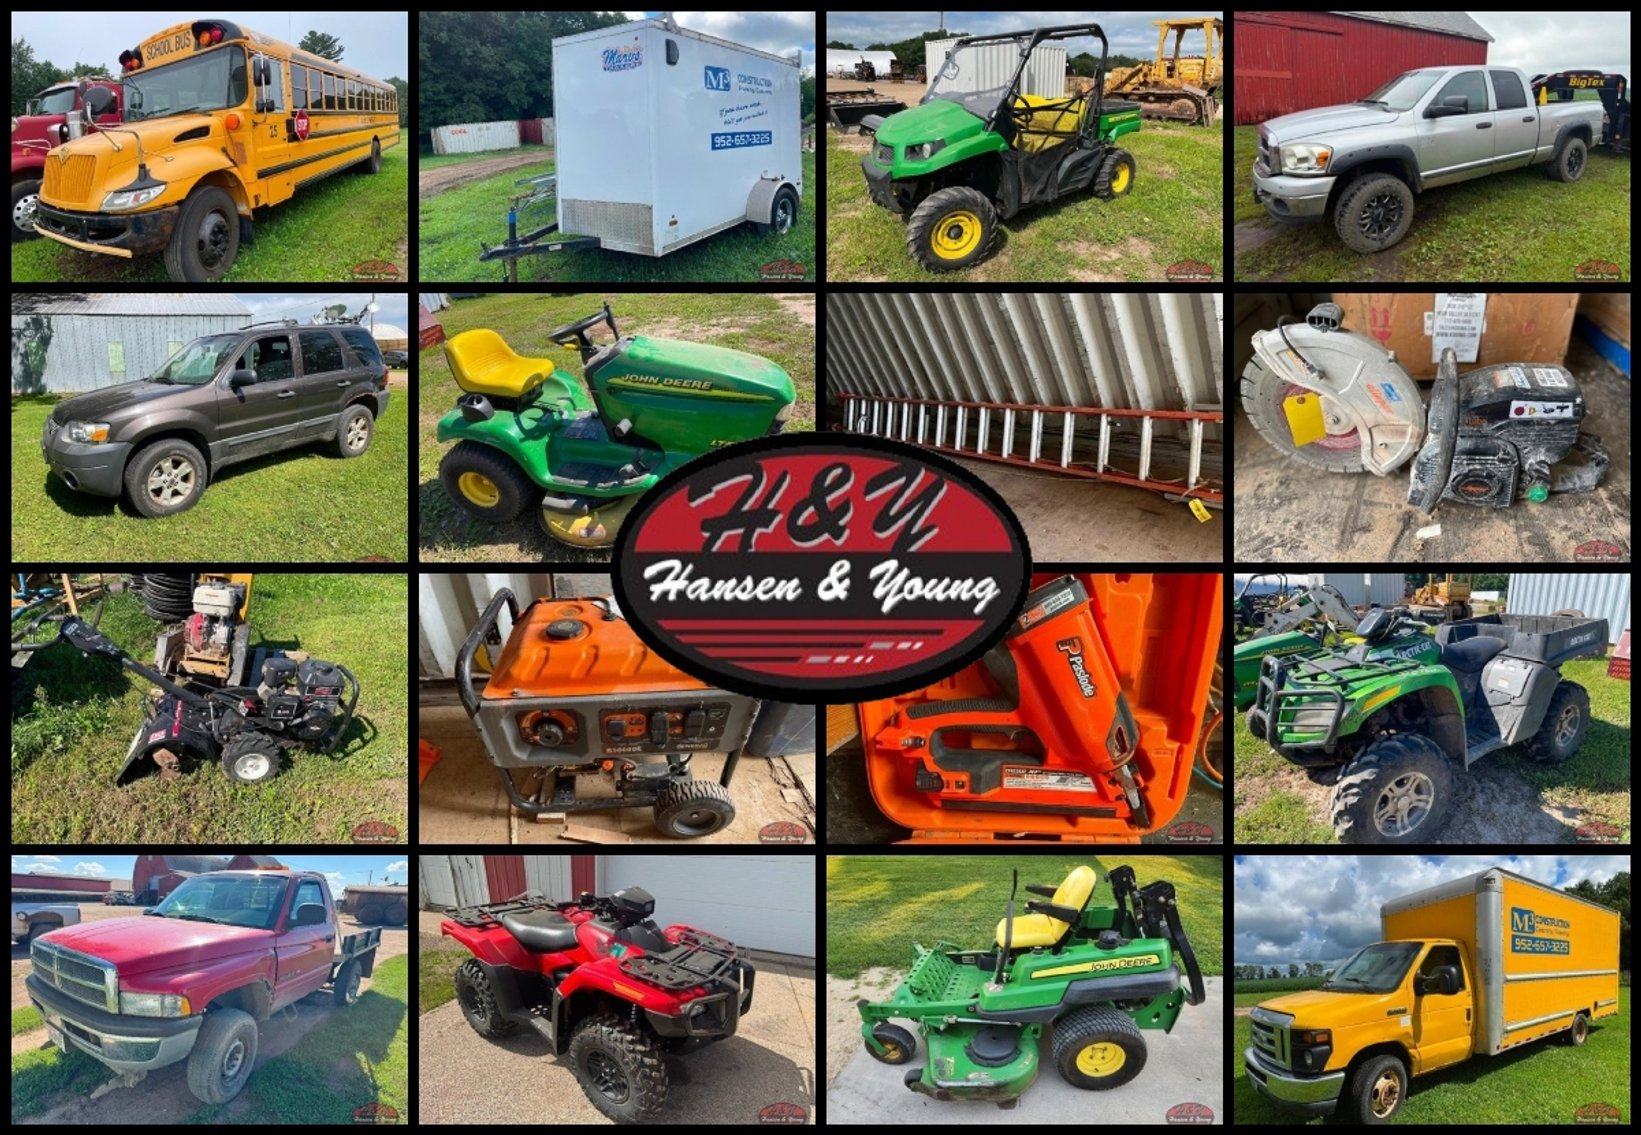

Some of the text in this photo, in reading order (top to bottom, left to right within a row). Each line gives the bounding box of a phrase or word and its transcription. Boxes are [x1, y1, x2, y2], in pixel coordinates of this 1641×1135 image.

[147, 30, 191, 61] SCHOOL BUS
[713, 132, 770, 148] 952-657-3225
[622, 373, 713, 391] JOHN DEERE
[1069, 655, 1095, 698] Paslode
[1514, 938, 1568, 953] 952-657-3225
[1090, 956, 1153, 972] JOHN DEERE
